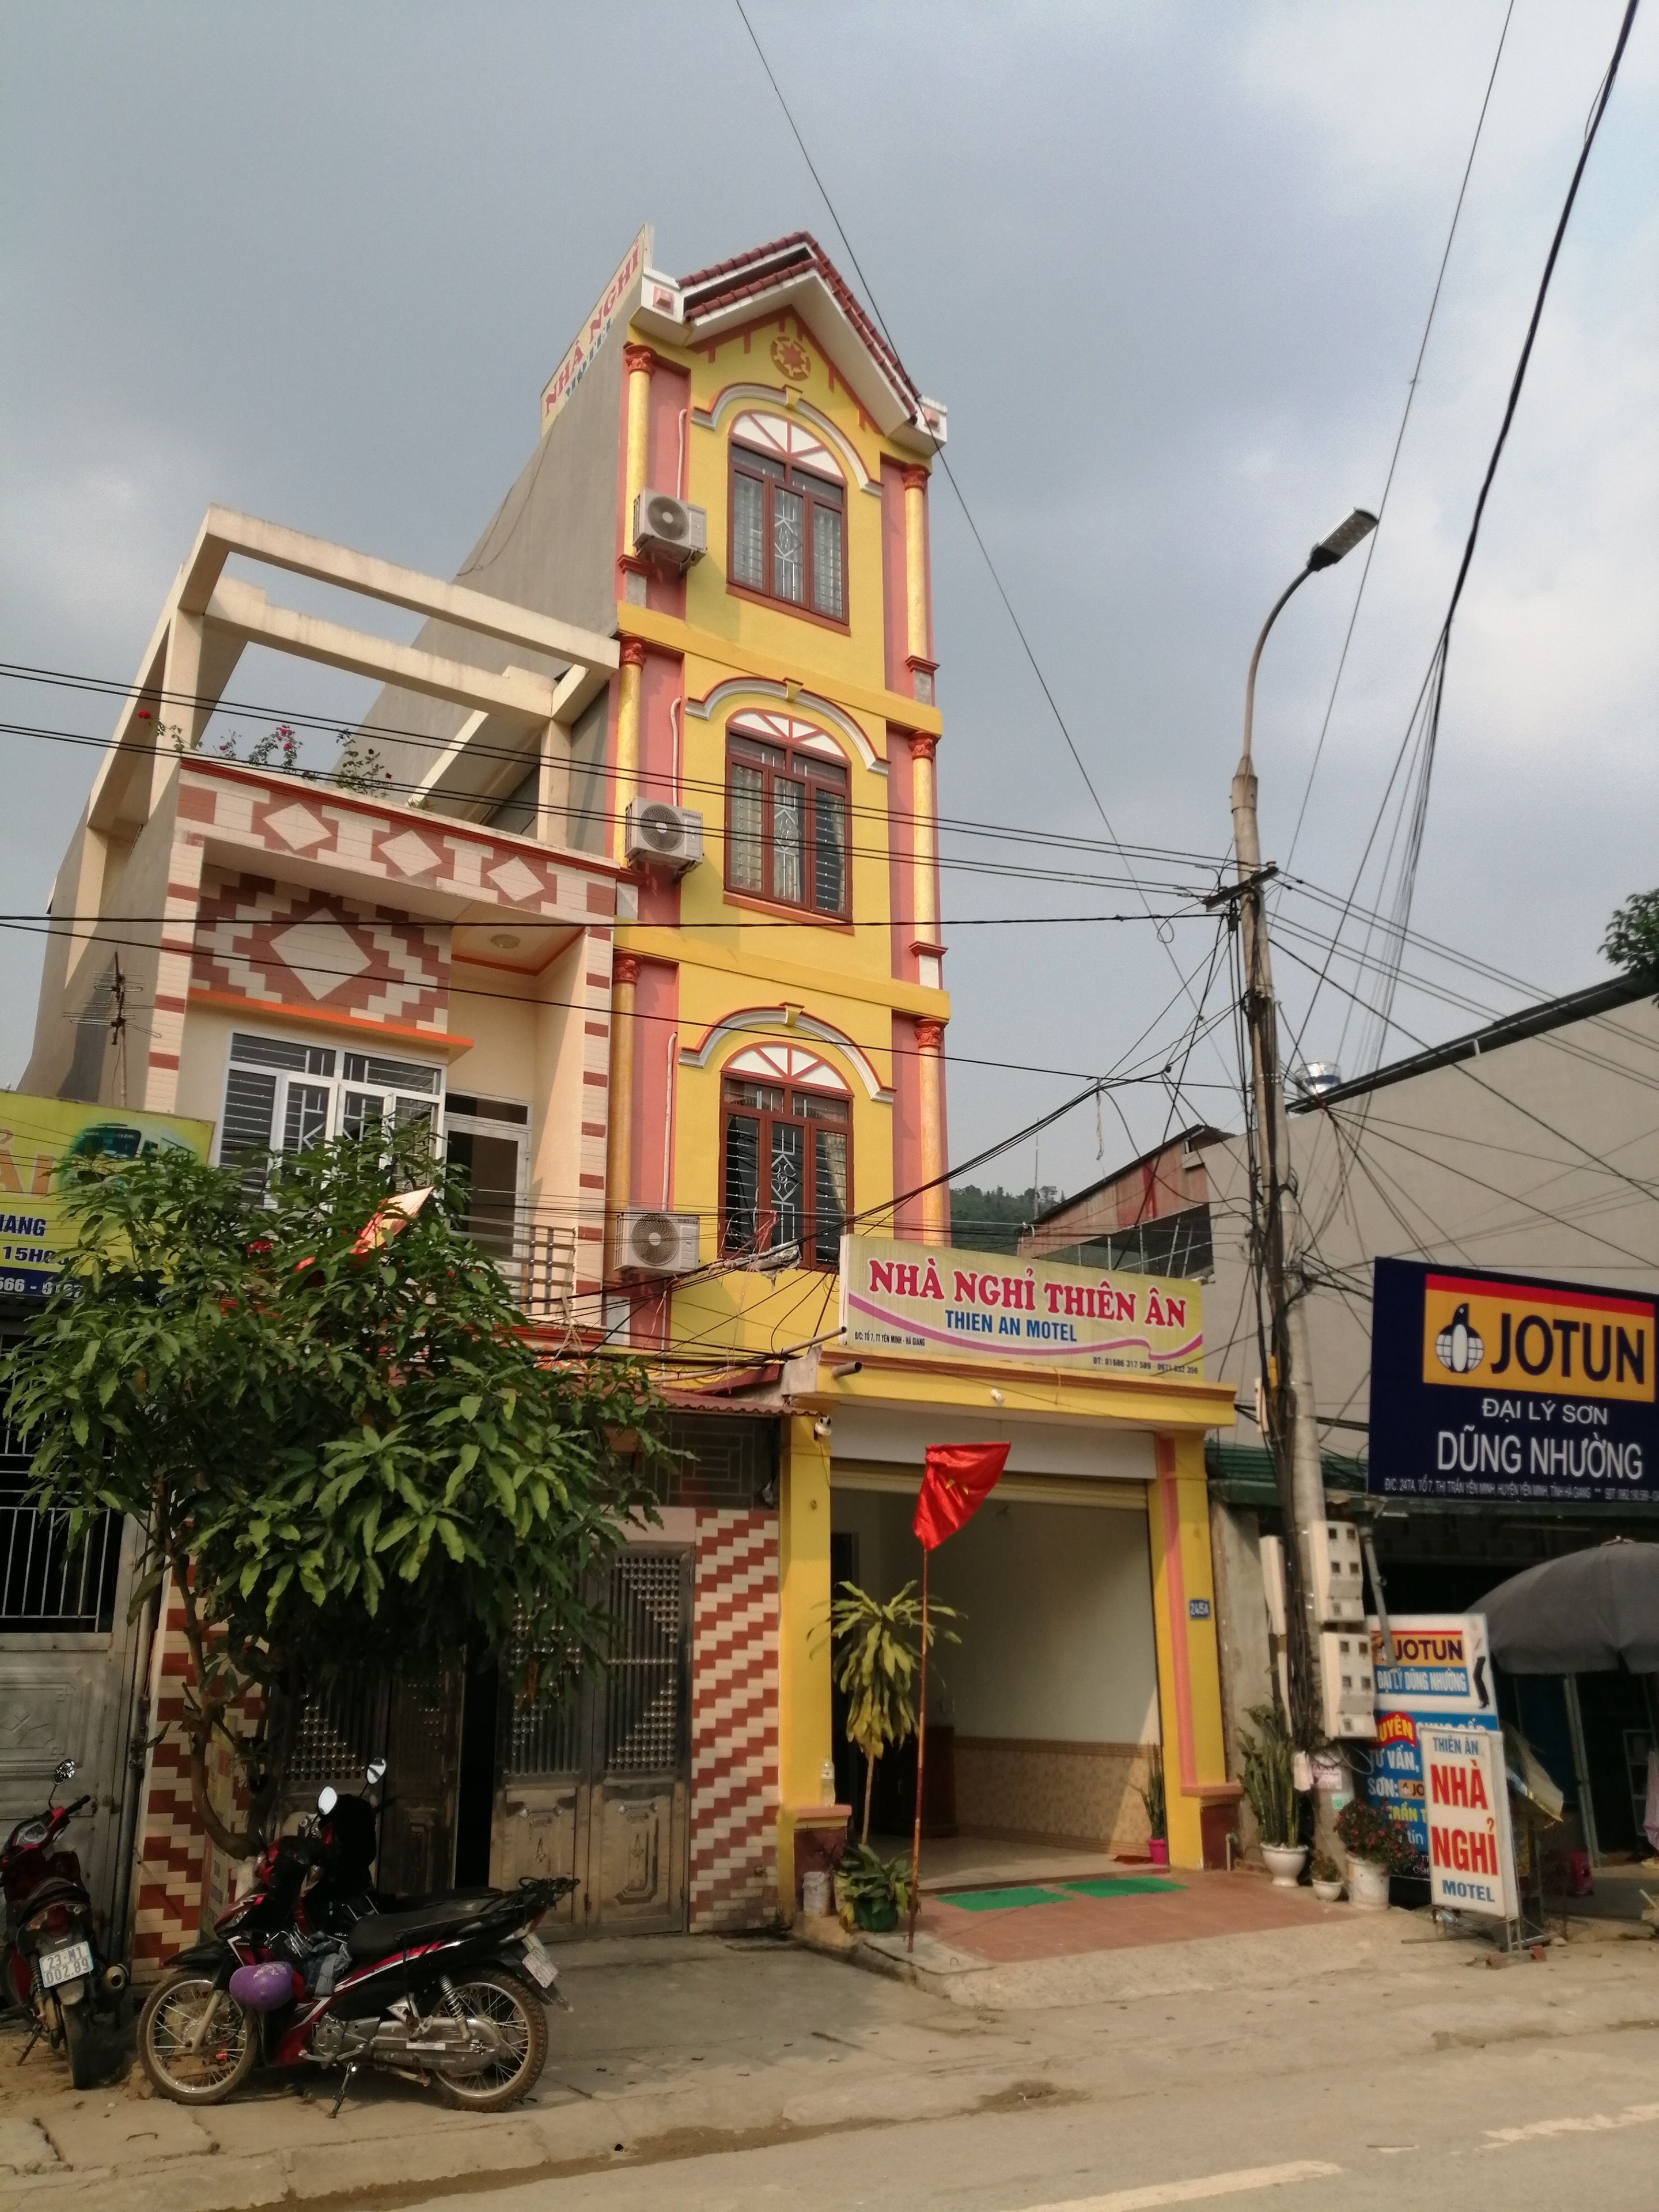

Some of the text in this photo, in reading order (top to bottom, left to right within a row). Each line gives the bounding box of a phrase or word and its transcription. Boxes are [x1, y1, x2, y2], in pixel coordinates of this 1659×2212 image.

[544, 340, 584, 418] NHÀ
[869, 1258, 1187, 1328] NHÀ NGHỈ THIÊN ÂN
[876, 1334, 881, 1342] TT
[881, 1332, 890, 1343] YÊN
[891, 1336, 902, 1344] MINH
[906, 1335, 912, 1345] HÀ
[912, 1338, 925, 1346] GIANG
[945, 1309, 1077, 1343] THIEN AN MOTEL
[1490, 1312, 1645, 1385] JOTUN
[1482, 1398, 1608, 1426] ĐẠI LÝ SƠN
[1437, 1425, 1643, 1480] DŨNG NHƯỜNG
[1396, 1639, 1464, 1660] JOTUN
[1378, 1714, 1414, 1742] UYÊN
[1433, 1733, 1479, 1756] THIÊN ÂN
[1368, 1776, 1399, 1797] SƠN:
[1430, 1759, 1488, 1810] NHÀ
[1431, 1817, 1498, 1876] NGHỈ
[1442, 1879, 1495, 1903] MOTEL
[46, 1958, 89, 1984] 002.89
